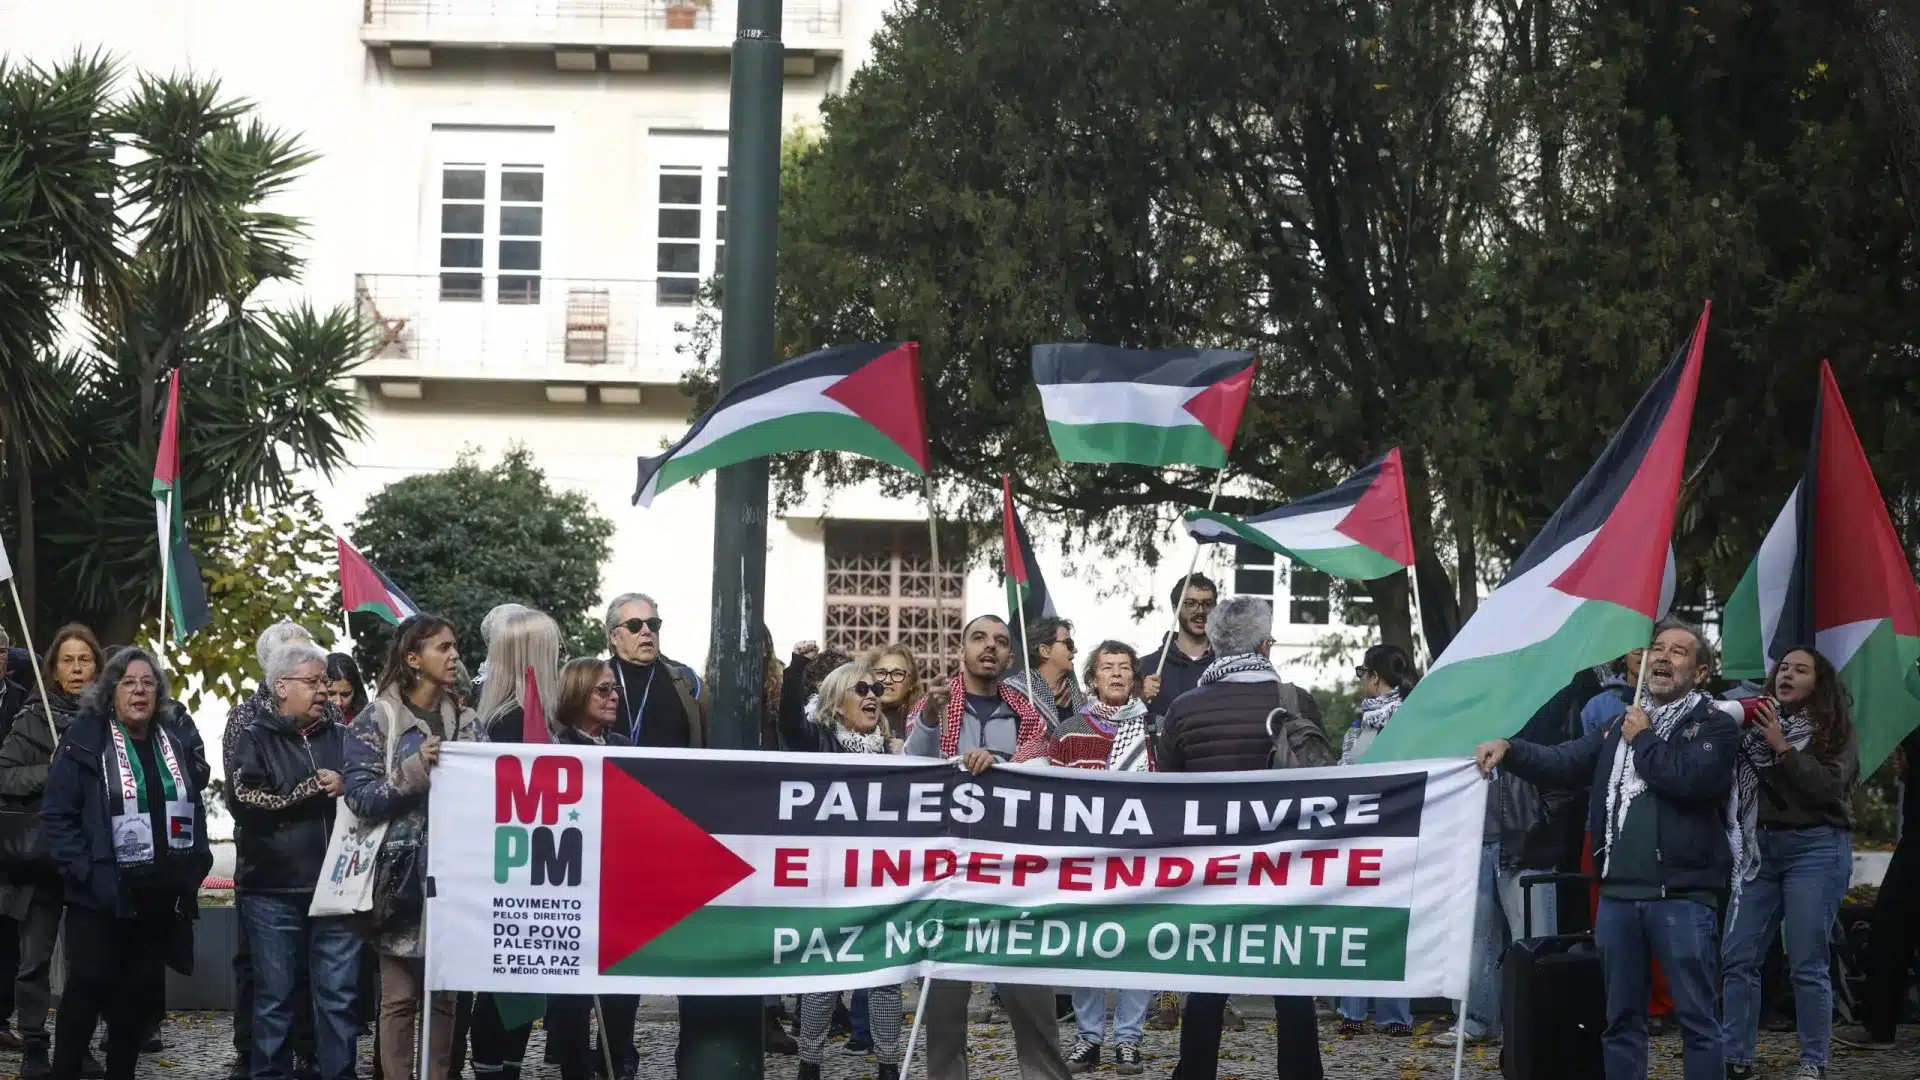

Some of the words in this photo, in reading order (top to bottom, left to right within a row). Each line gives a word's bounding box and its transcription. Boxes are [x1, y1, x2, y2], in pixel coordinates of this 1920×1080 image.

[495, 754, 583, 825] MP
[778, 780, 1153, 835] PALESTINA
[1183, 793, 1382, 835] LIVRE
[494, 826, 583, 886] PM
[773, 848, 809, 887] E
[844, 848, 1383, 891] INDEPENDENTE
[493, 897, 581, 910] MOVIMENTO
[493, 911, 528, 919] PELOS
[533, 912, 581, 921] DIREITOS
[493, 923, 520, 936] DO
[529, 925, 581, 939] POVO
[773, 926, 864, 964] PAZ
[885, 919, 944, 958] NO
[964, 911, 1126, 959] MÉDIO
[1147, 922, 1369, 967] ORIENTE
[493, 938, 580, 951] PALESTINO
[493, 954, 502, 965] E
[507, 954, 545, 966] PELA
[550, 955, 580, 967] PAZ
[510, 966, 538, 975] MÉDIO
[541, 968, 580, 976] ORIENTE
